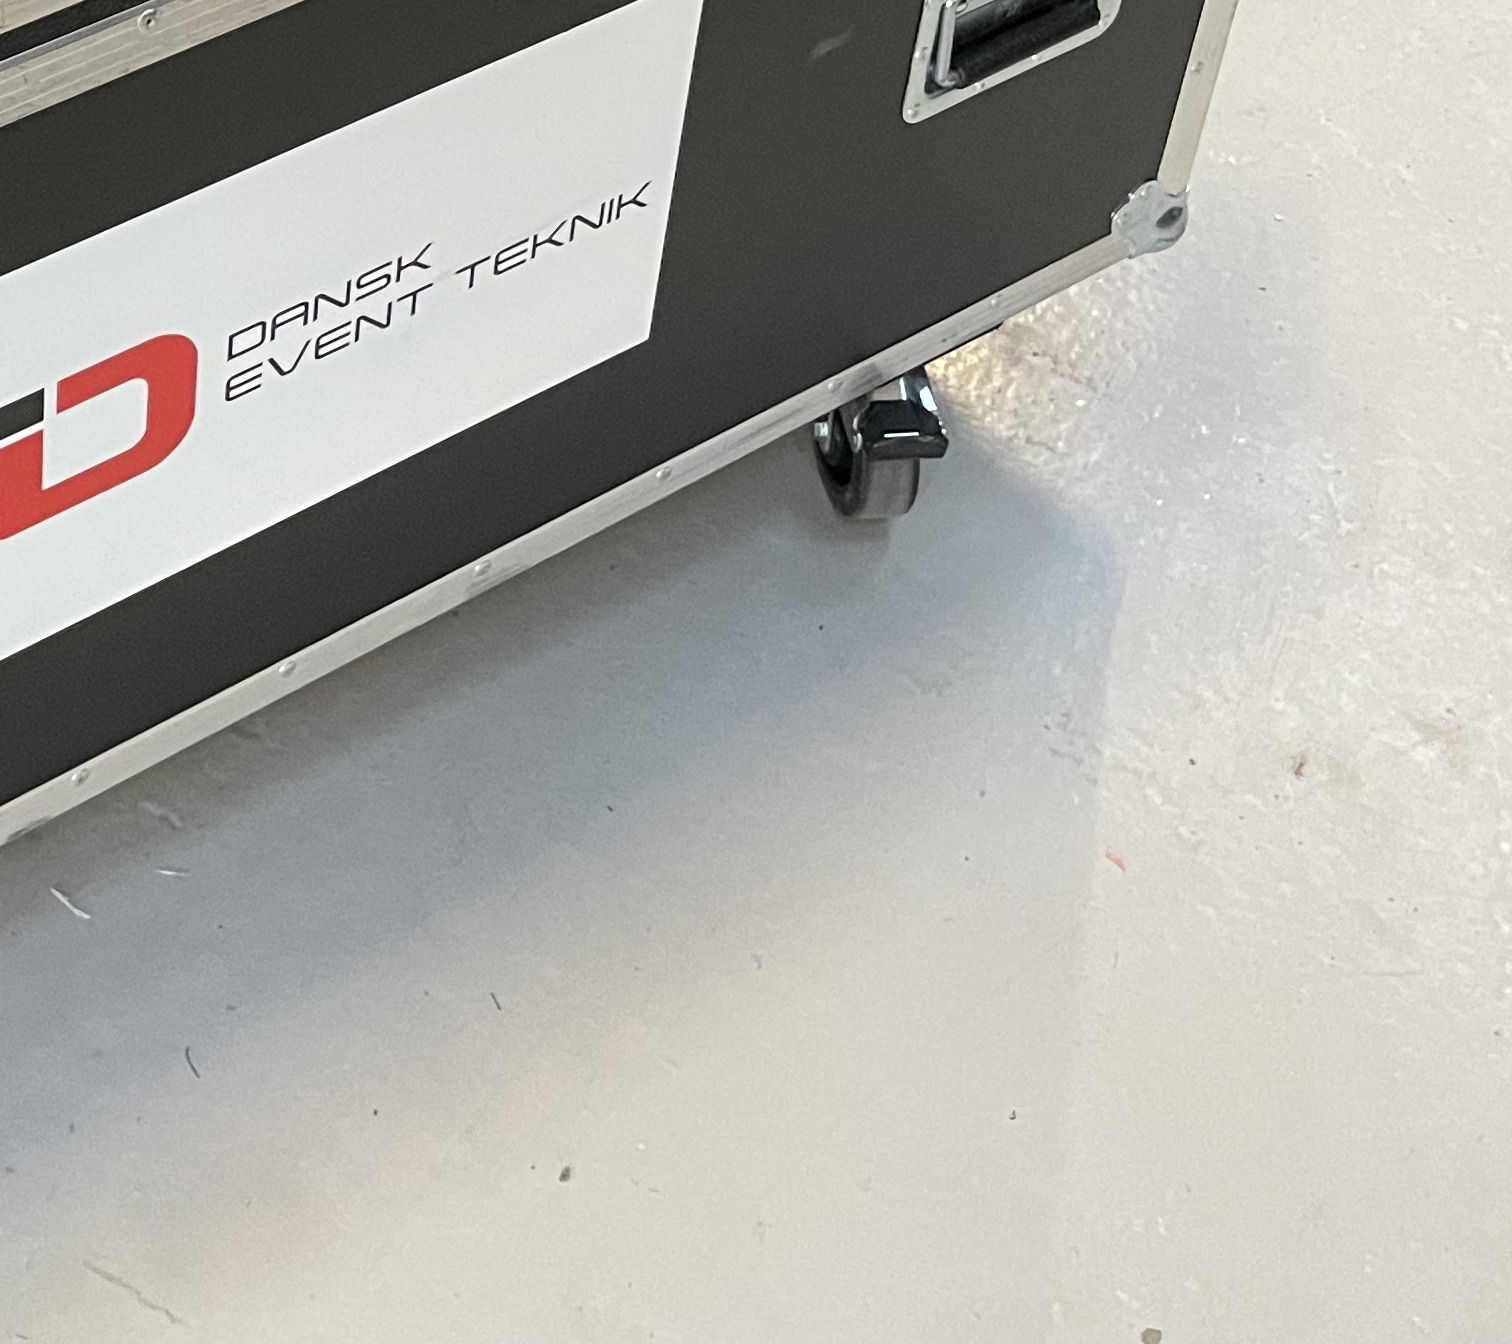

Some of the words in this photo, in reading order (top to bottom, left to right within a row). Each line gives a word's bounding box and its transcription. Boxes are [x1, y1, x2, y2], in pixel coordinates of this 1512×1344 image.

[224, 282, 434, 402] EVENT
[455, 180, 652, 289] TEKNIK
[227, 242, 434, 362] DANSK
